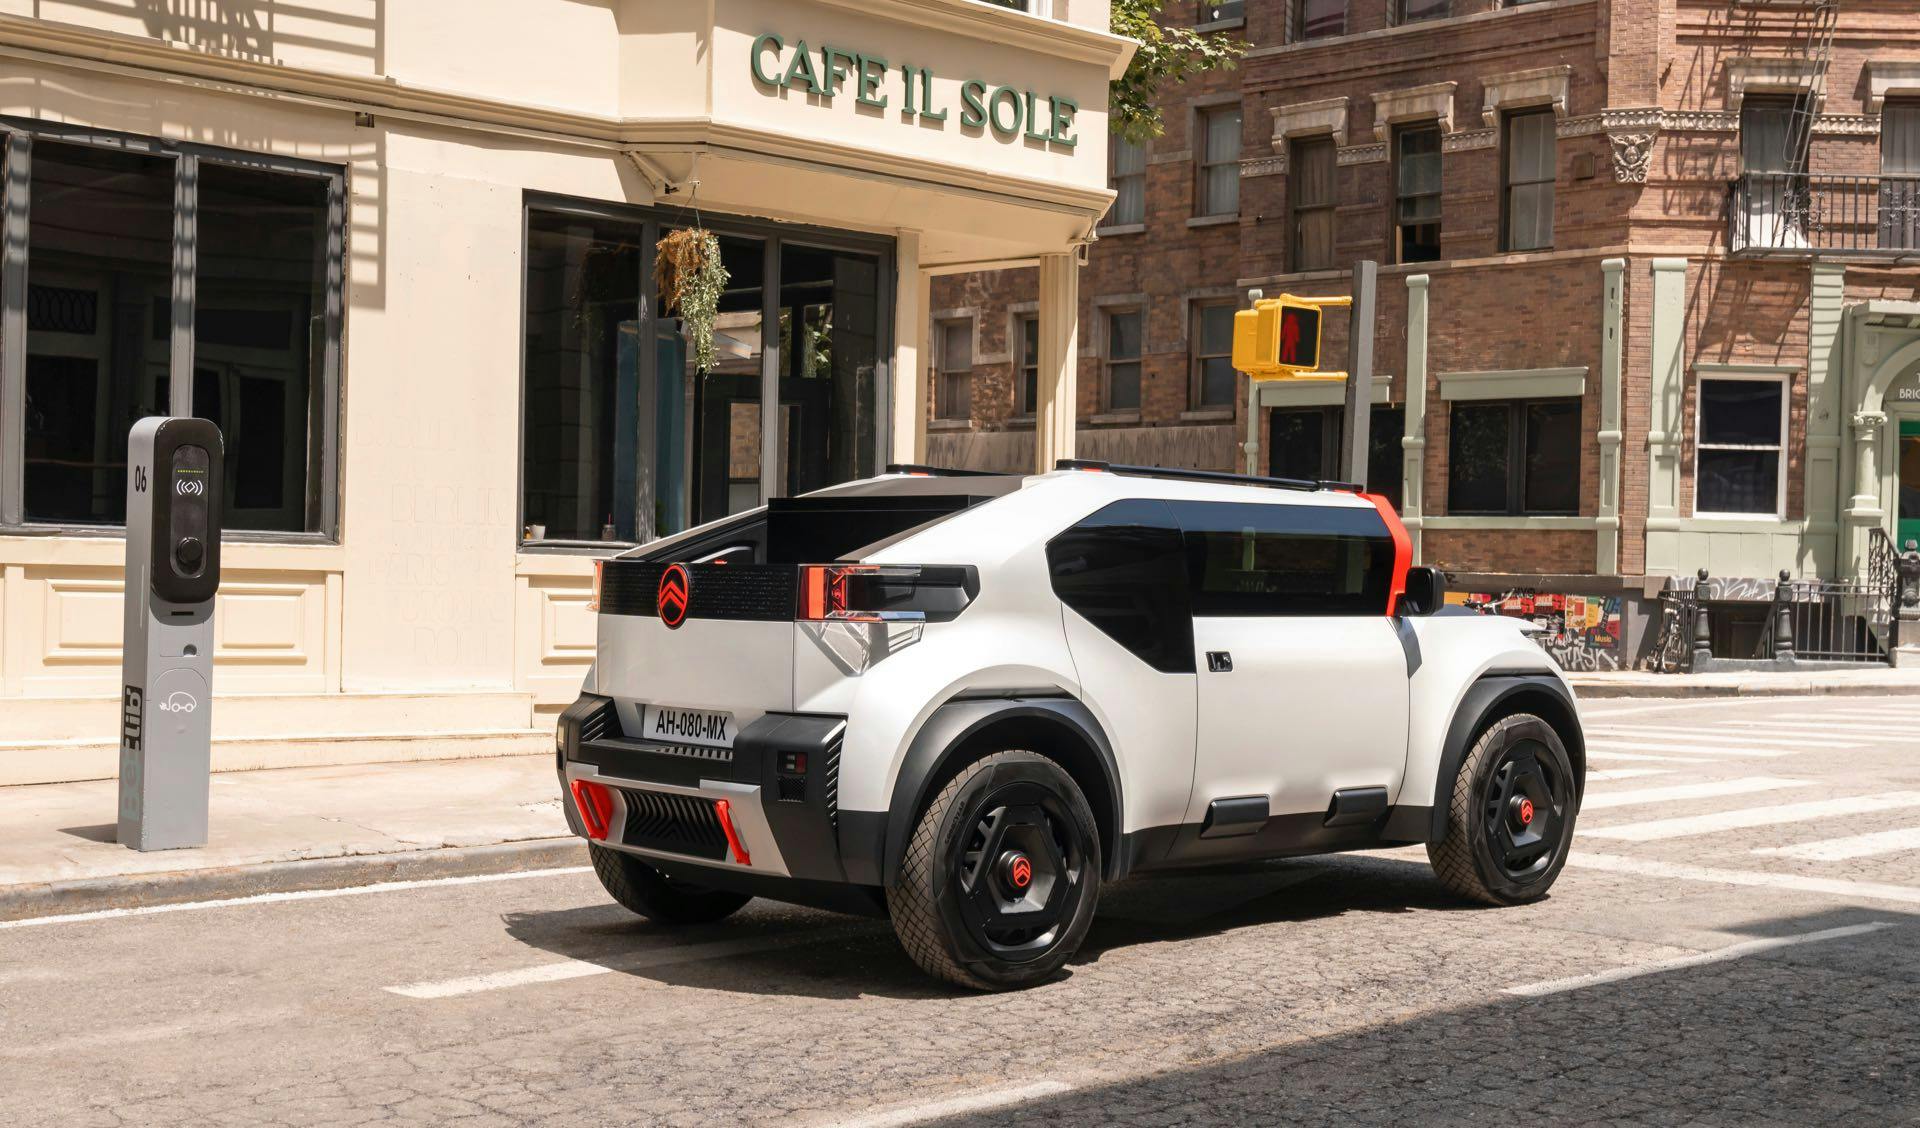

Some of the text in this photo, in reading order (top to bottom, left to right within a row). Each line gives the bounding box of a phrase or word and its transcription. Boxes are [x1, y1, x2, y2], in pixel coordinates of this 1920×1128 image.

[751, 32, 1078, 147] CAFE IL SOLE
[135, 464, 147, 493] 06
[656, 709, 728, 740] AH-080-MX
